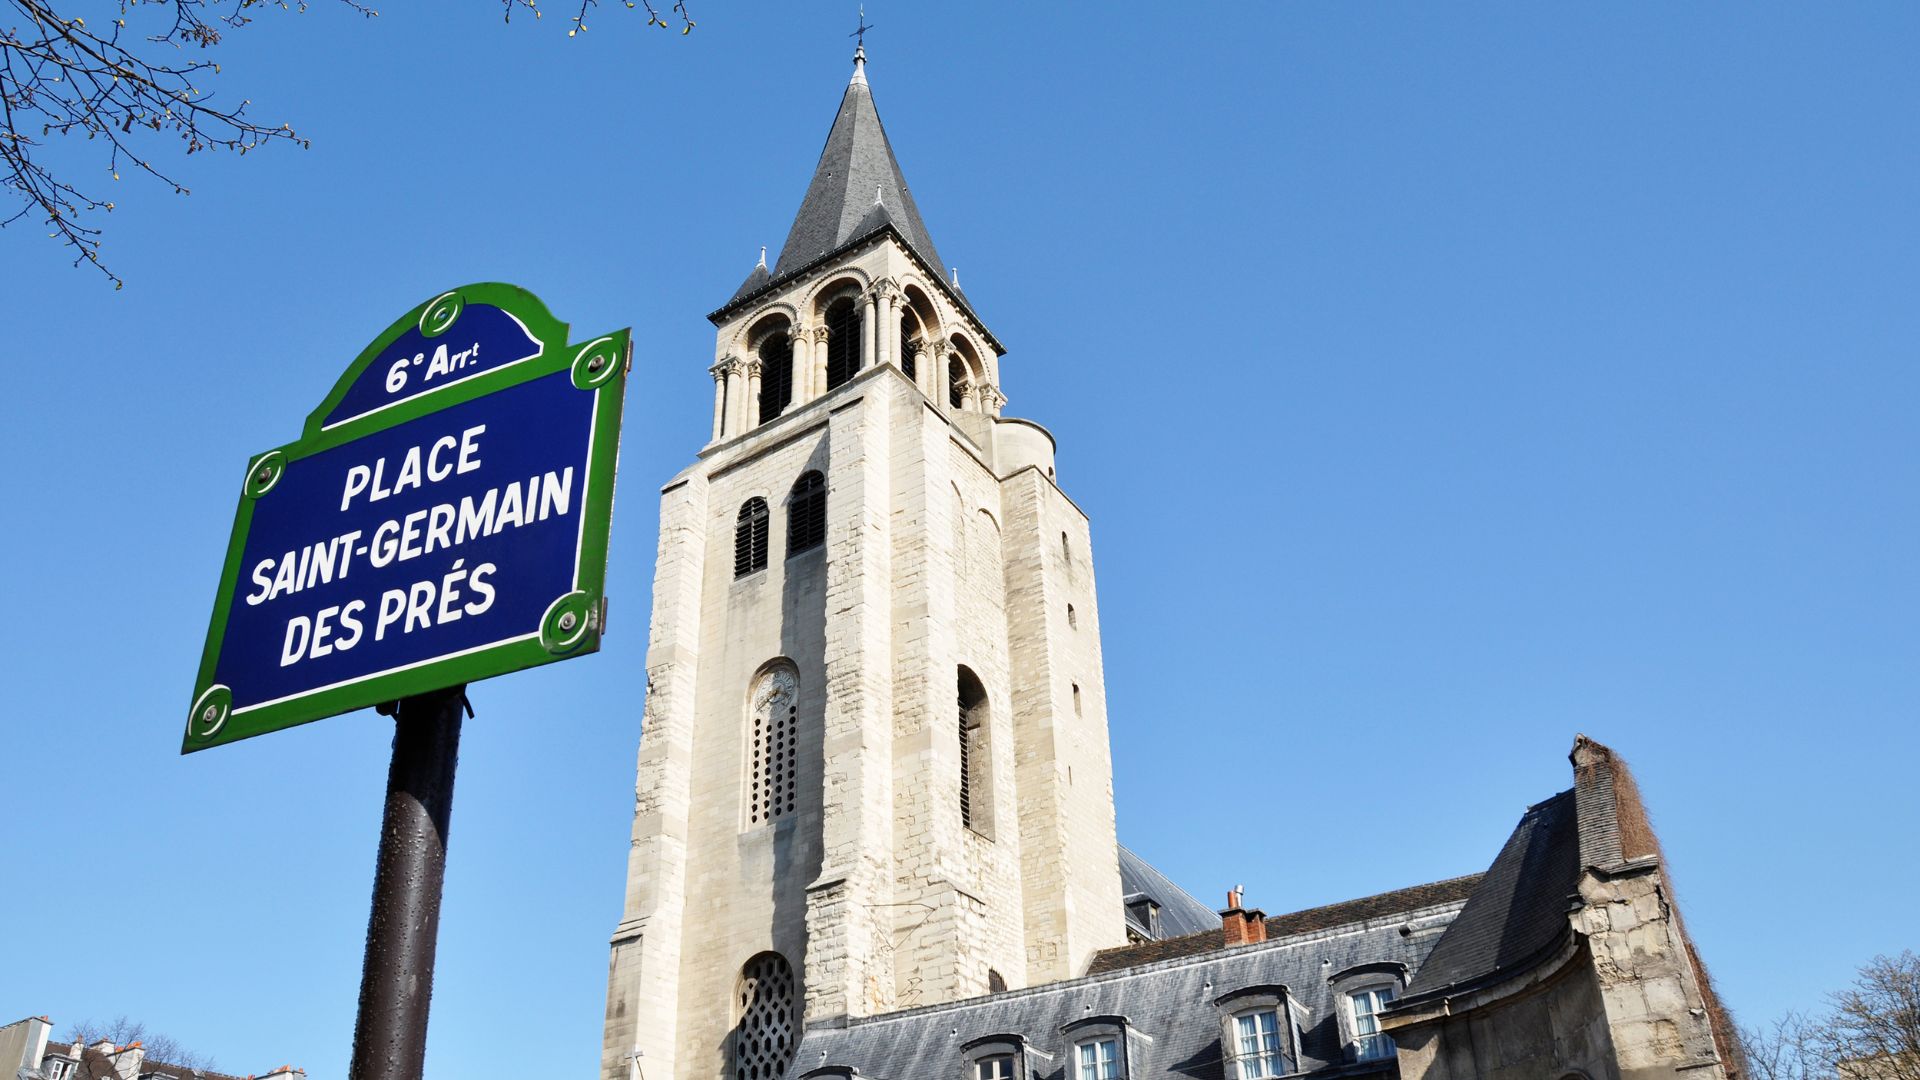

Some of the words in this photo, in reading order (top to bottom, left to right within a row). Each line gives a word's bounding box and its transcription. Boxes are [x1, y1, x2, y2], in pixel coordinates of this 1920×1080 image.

[341, 424, 486, 512] PLACE
[246, 466, 574, 606] SAINT-GERMAIN
[279, 600, 366, 667] DES
[374, 559, 497, 642] PRÉS
